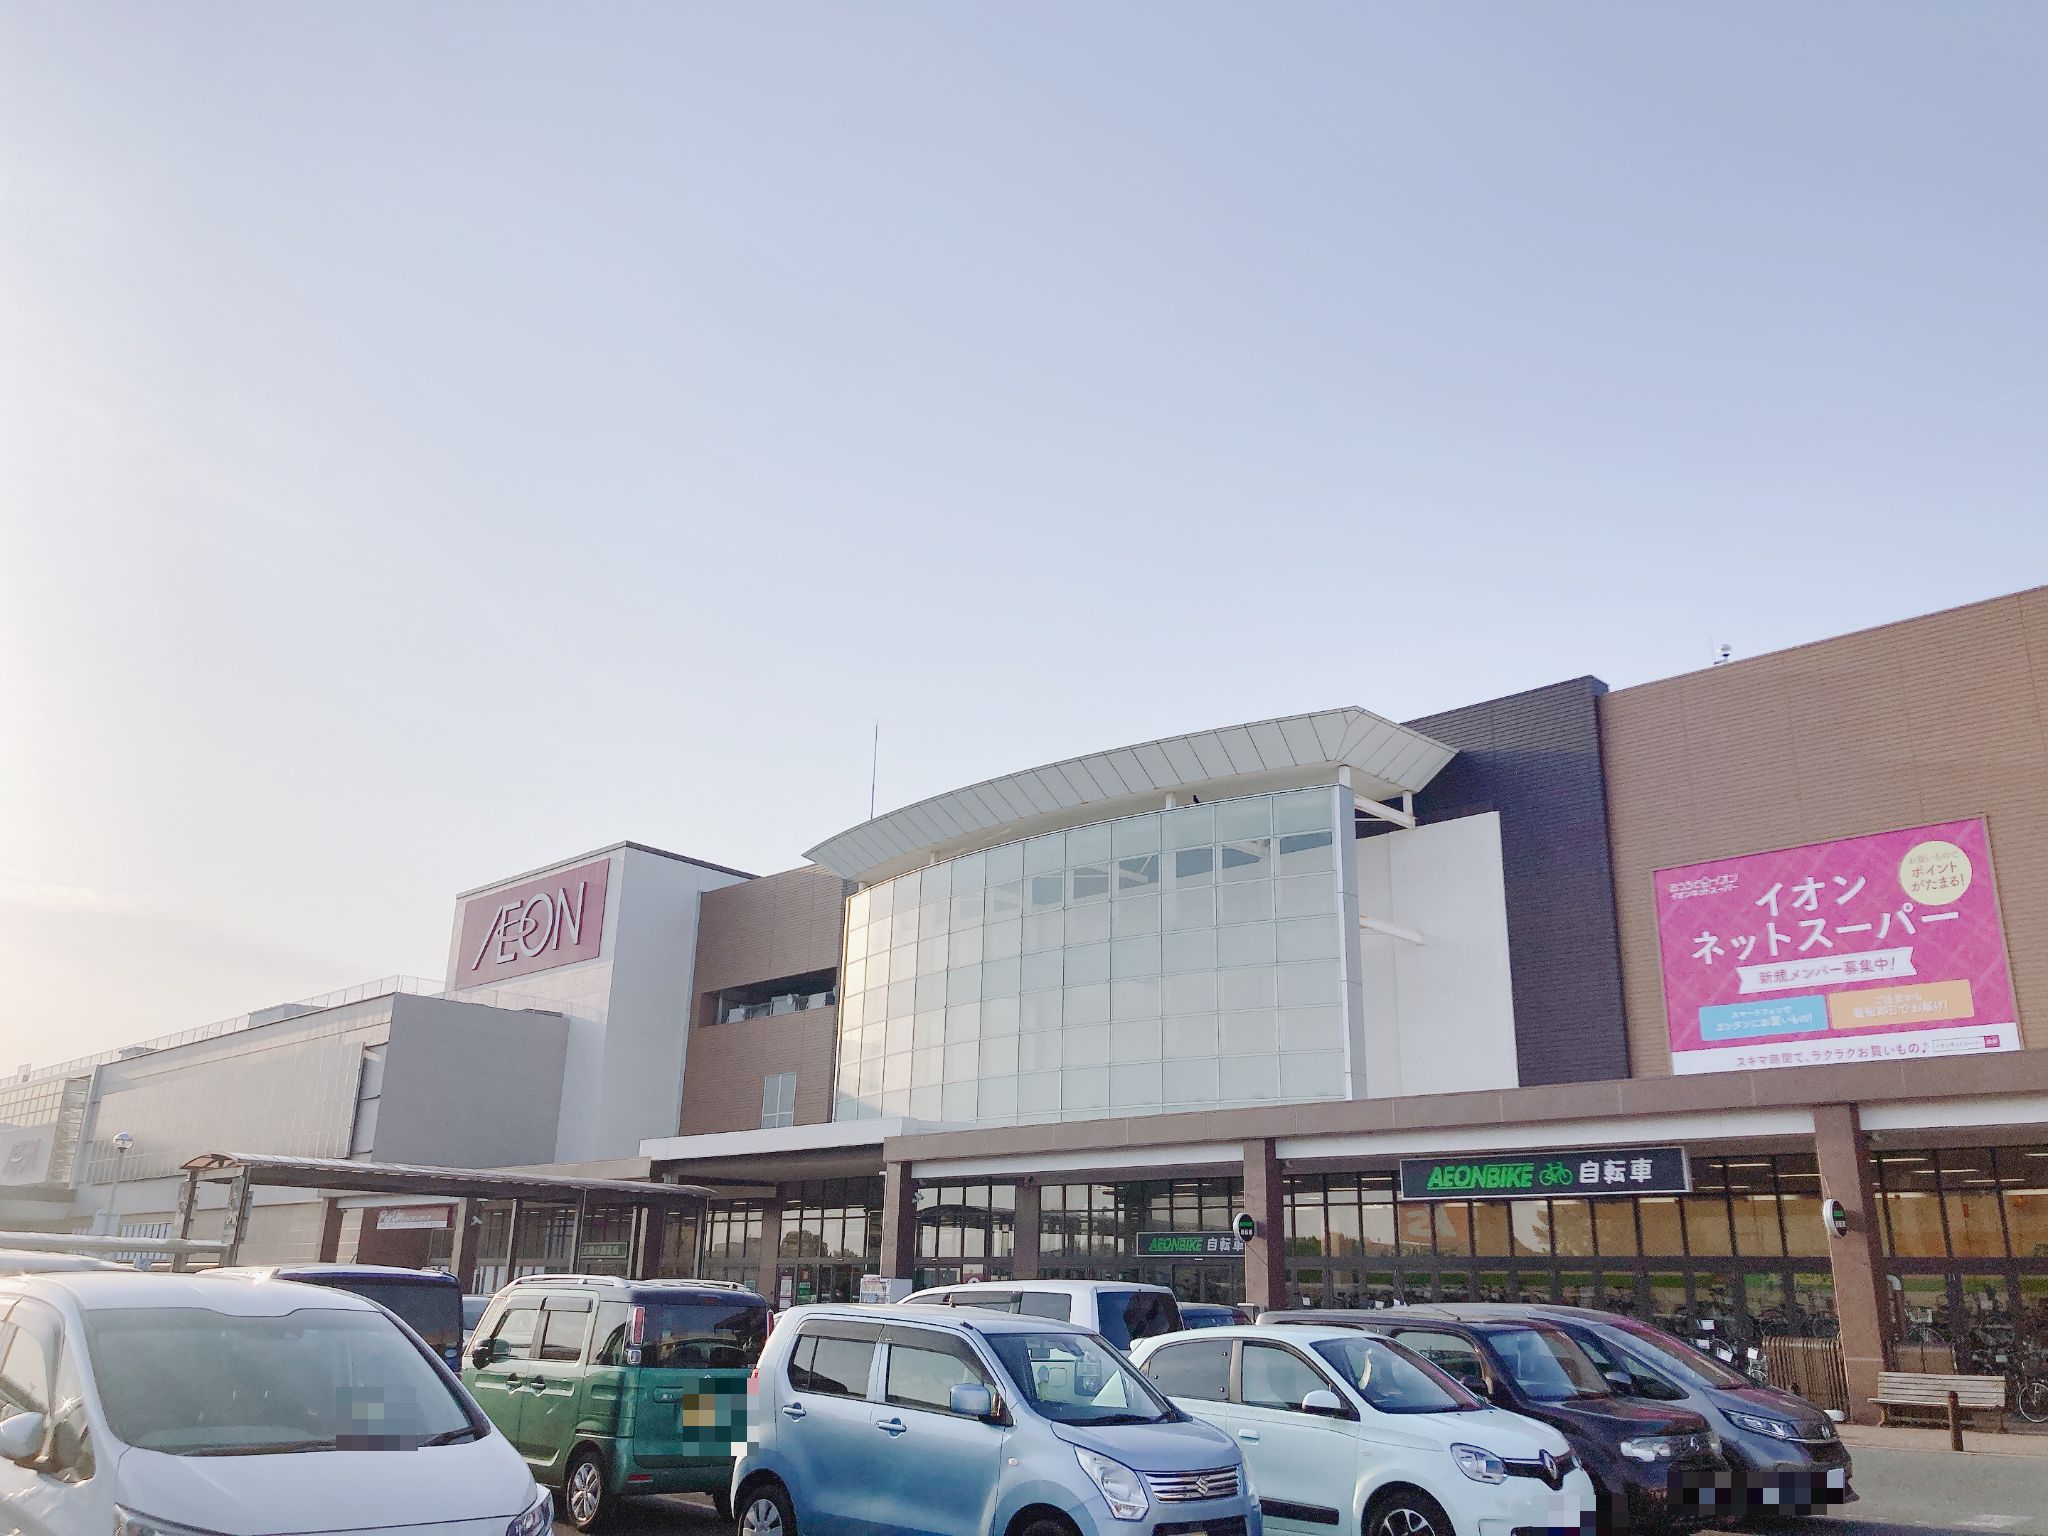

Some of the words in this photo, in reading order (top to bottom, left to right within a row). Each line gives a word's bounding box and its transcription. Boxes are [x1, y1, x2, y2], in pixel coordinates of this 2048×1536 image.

[1911, 861, 1958, 878] ポイント
[1911, 873, 1965, 892] がたまる!
[1755, 875, 1867, 917] イオン
[1691, 902, 1960, 966] ネットスーパー
[1759, 956, 1896, 985] 新規メンバー募集中!
[1427, 1163, 1535, 1190] AEONBIKE
[1579, 1158, 1653, 1185] 自転車
[1149, 1237, 1203, 1252] AEONBIKE
[1206, 1237, 1245, 1252] 自転車
